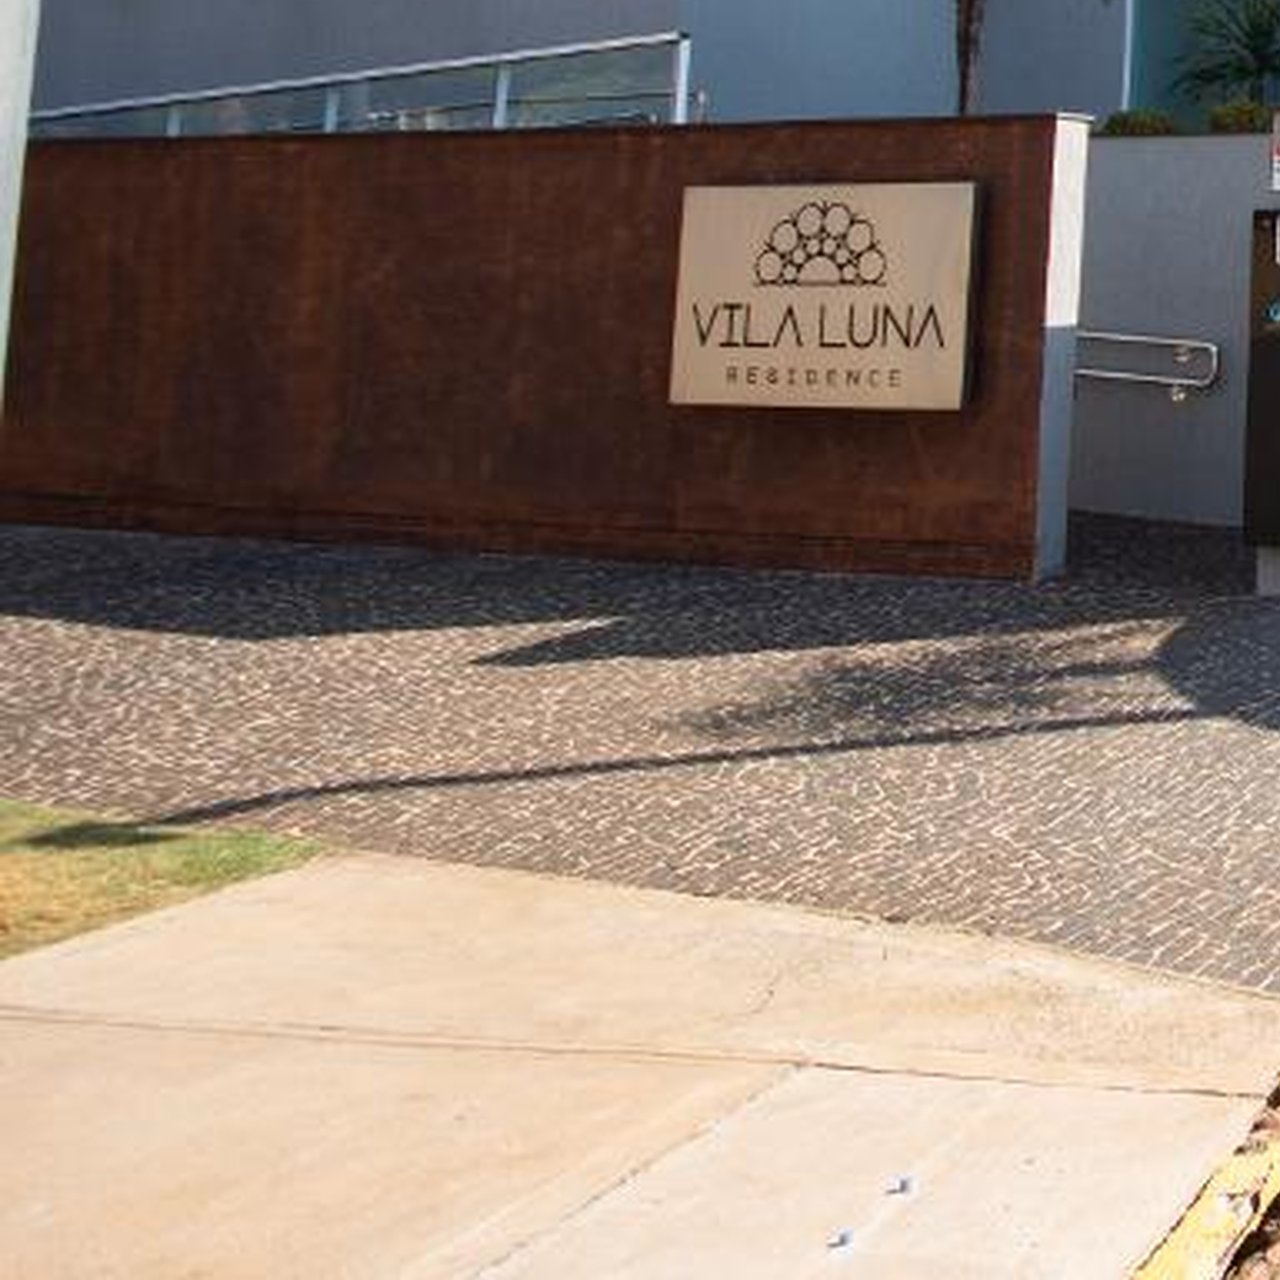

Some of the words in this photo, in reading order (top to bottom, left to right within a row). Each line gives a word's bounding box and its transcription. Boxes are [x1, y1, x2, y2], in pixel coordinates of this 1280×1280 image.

[693, 303, 803, 348] VILA
[819, 303, 945, 349] LUNA
[726, 366, 902, 388] RESIDENCE
